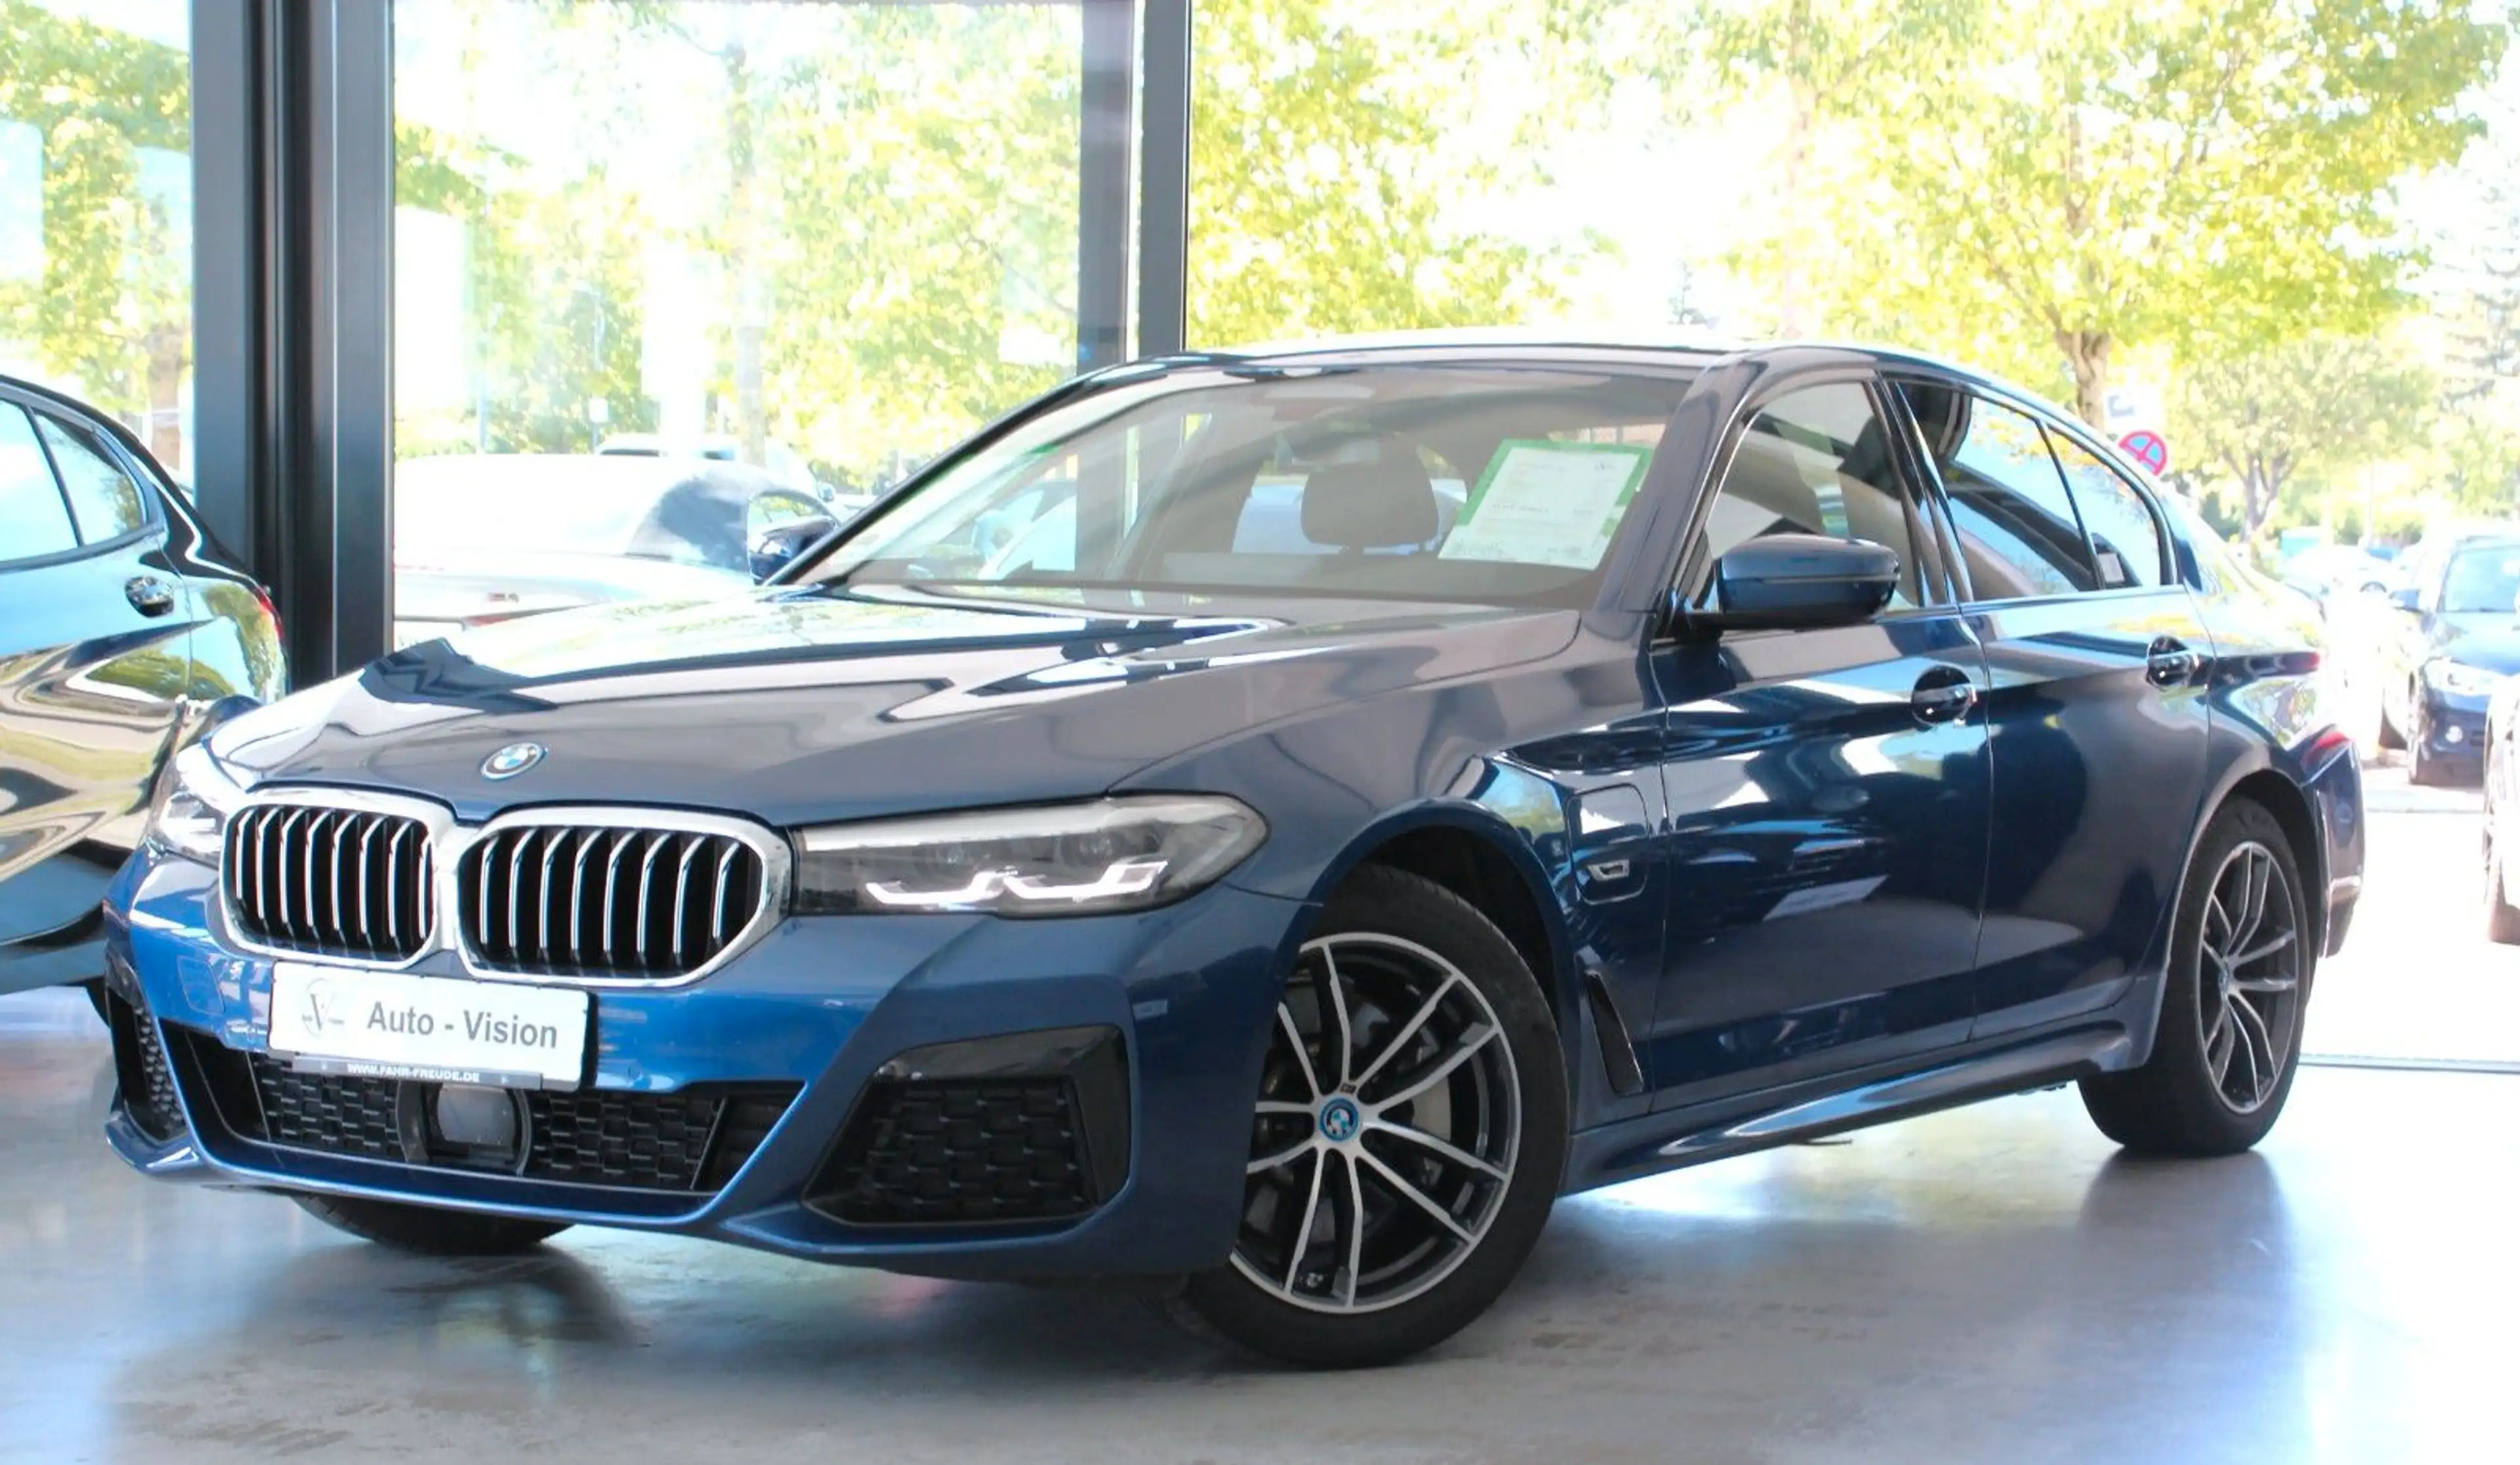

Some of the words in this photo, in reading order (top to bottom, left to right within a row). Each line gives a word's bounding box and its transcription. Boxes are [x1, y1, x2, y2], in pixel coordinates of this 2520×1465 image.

[367, 1000, 434, 1036] Auto
[463, 1009, 557, 1049] Vision
[346, 1063, 480, 1083] WWW.FAHR-FREUDE.DE
